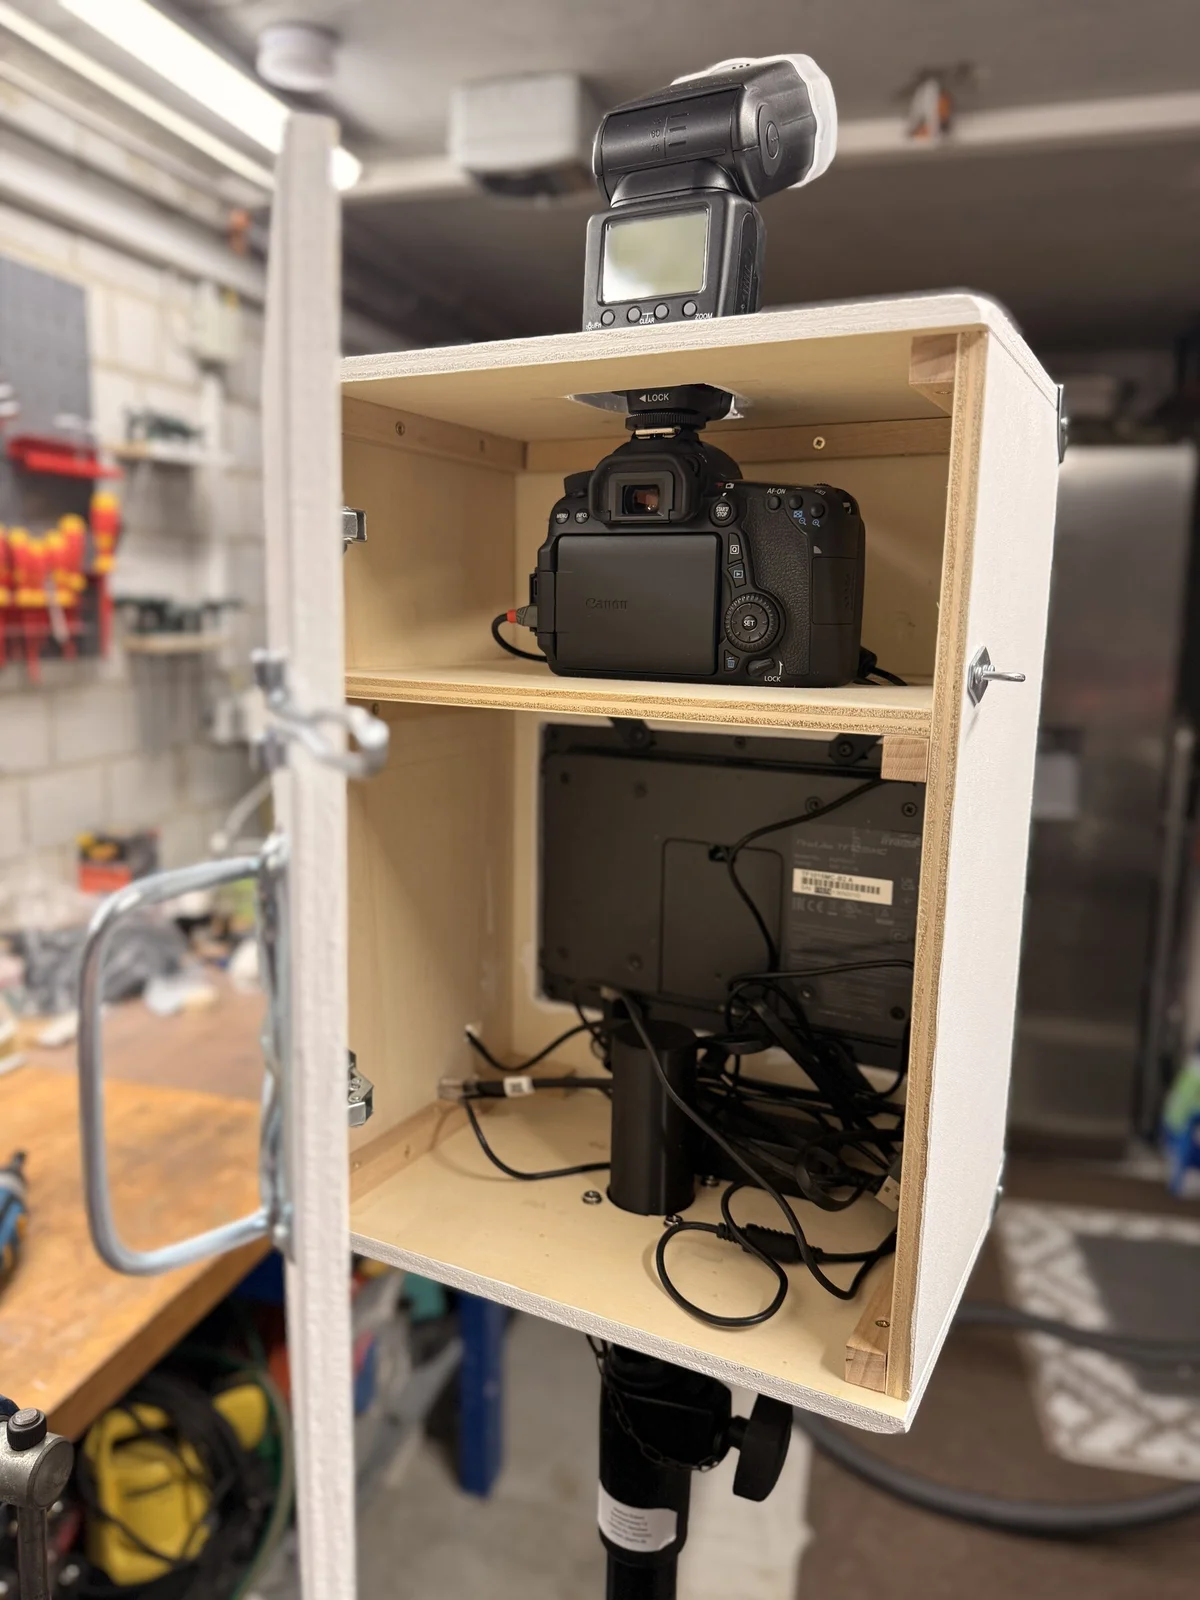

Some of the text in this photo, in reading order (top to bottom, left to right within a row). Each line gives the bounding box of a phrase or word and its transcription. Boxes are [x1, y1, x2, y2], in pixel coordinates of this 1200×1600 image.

[694, 312, 713, 320] ZOOM
[639, 316, 655, 325] CLEAR
[647, 393, 669, 403] LOCK
[766, 487, 786, 495] AF-ON
[585, 597, 628, 610] Canon
[743, 619, 755, 627] SET
[764, 675, 782, 683] LOCK
